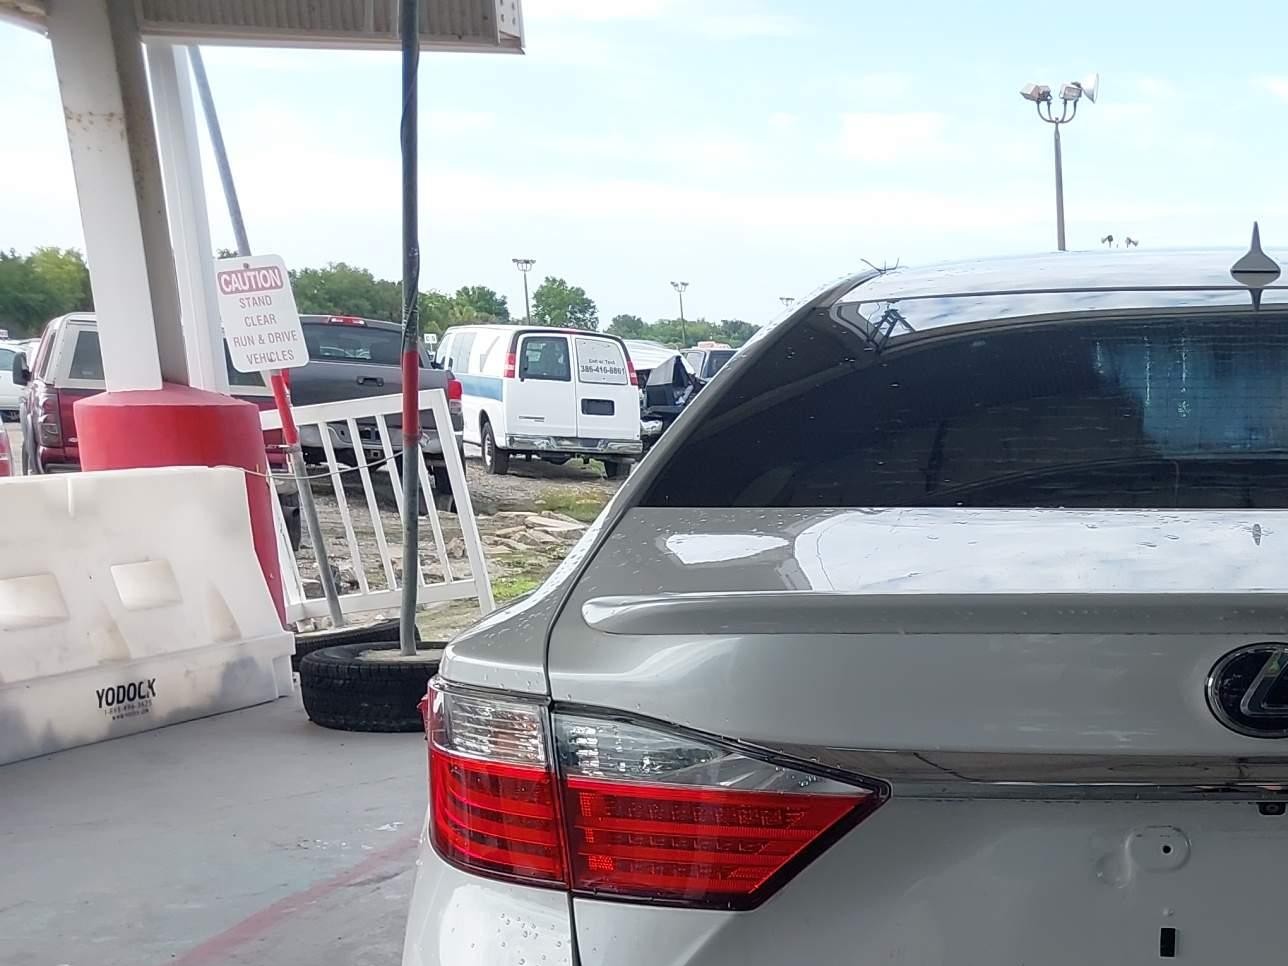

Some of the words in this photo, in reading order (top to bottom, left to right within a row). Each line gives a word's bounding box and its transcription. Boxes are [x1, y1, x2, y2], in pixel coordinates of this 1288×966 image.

[220, 268, 282, 292] CAUTION
[239, 295, 273, 309] STAND
[243, 313, 278, 328] CLEAR
[233, 336, 256, 349] RUN
[259, 335, 266, 345] &
[267, 330, 298, 344] DRIVE
[246, 349, 295, 365] VEHICLES
[95, 677, 156, 709] YODOCK
